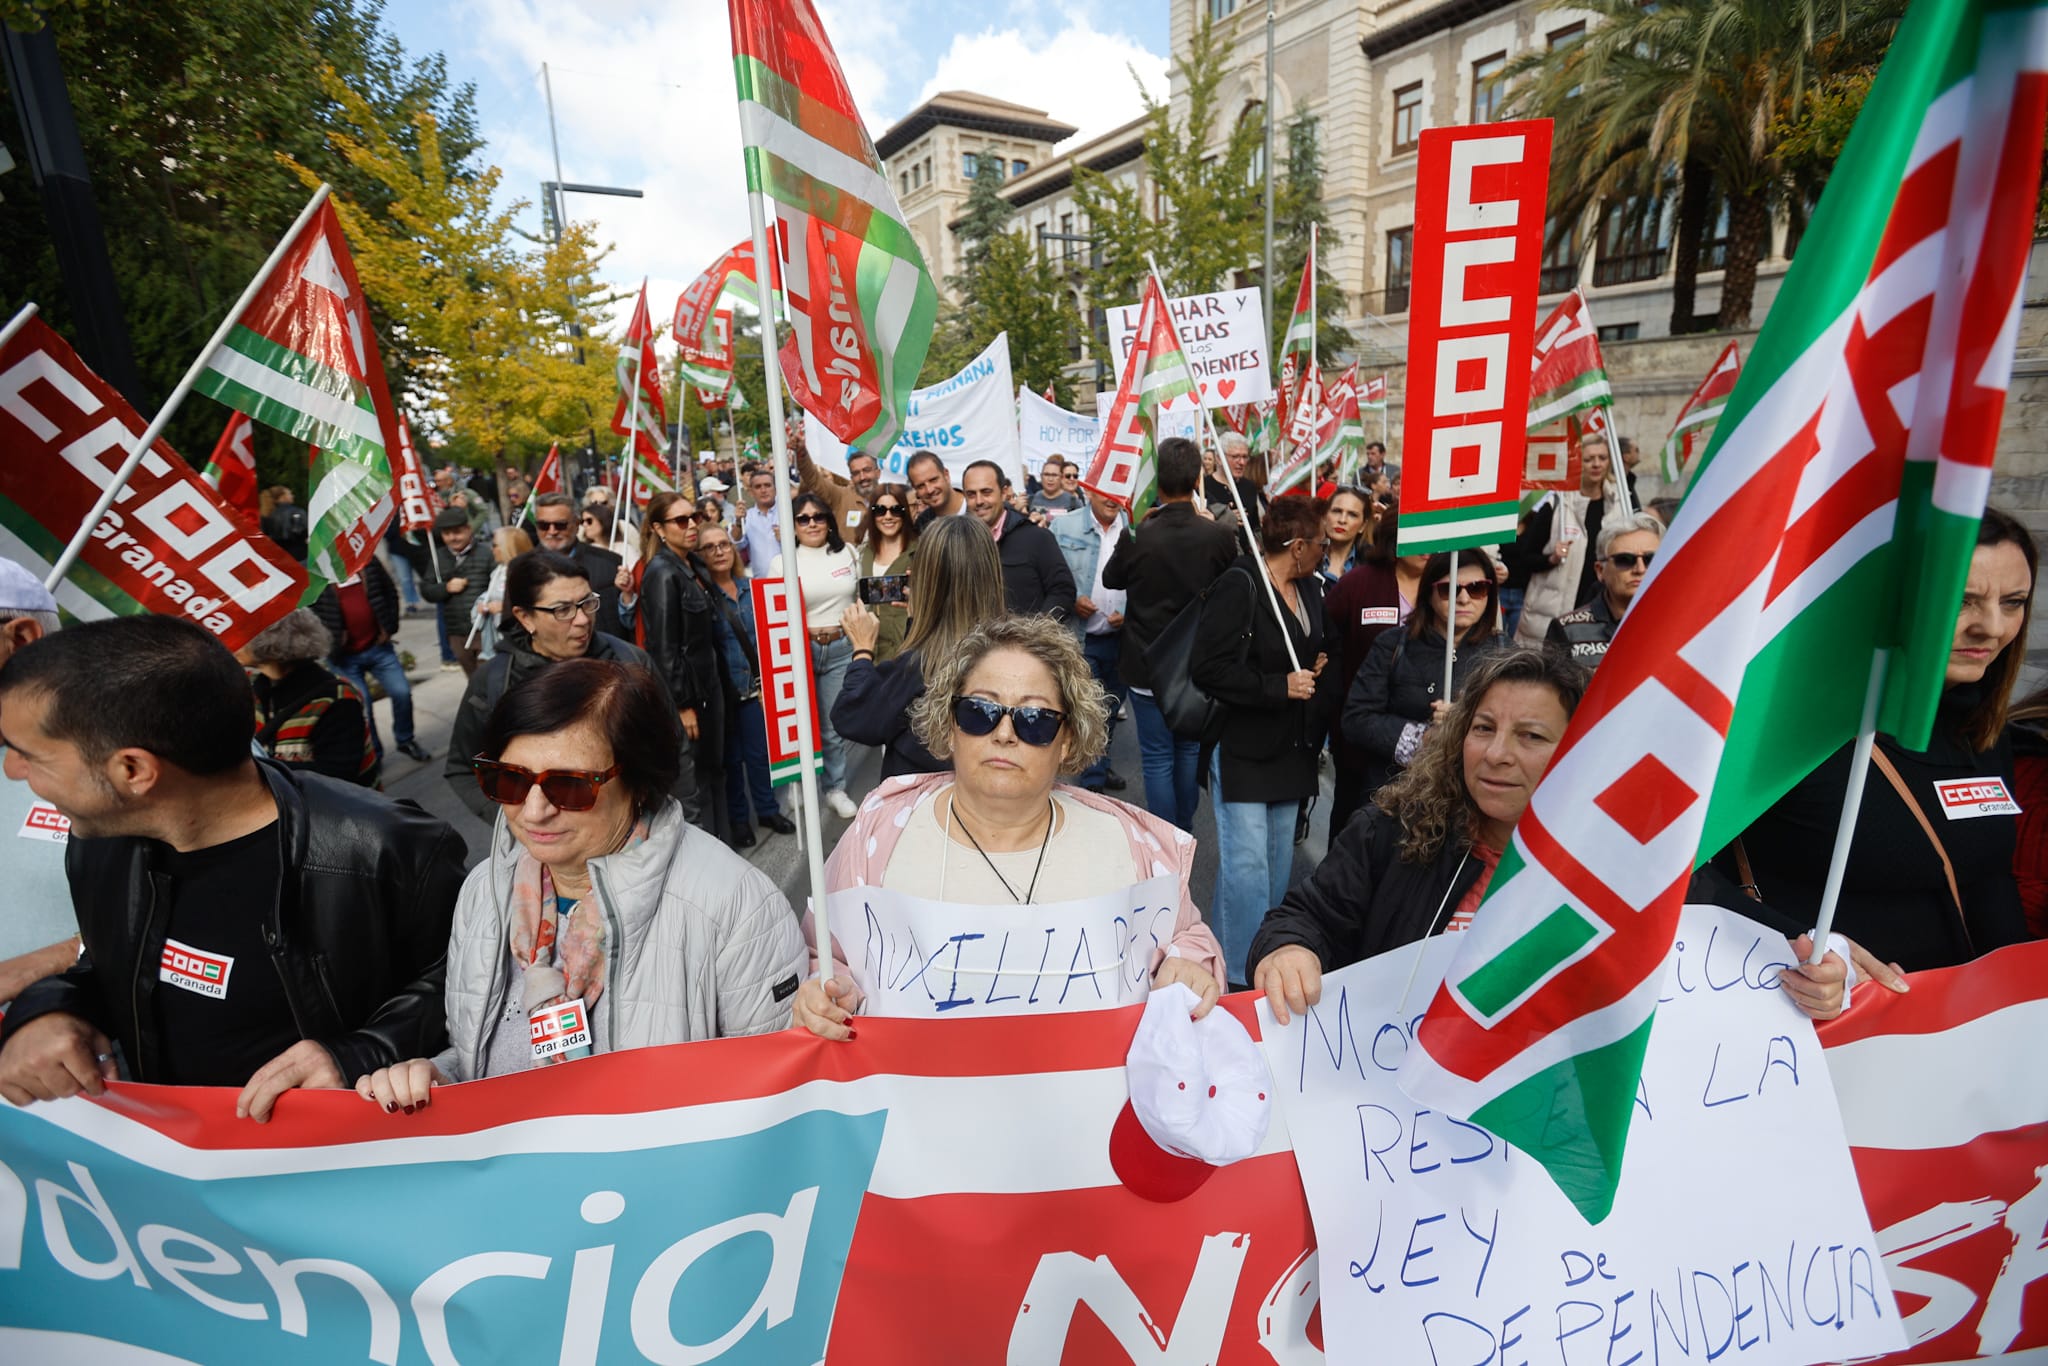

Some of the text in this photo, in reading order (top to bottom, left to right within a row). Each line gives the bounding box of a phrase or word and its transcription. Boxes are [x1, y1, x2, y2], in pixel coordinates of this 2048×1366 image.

[1123, 297, 1225, 331] LHAR
[1428, 135, 1525, 500] CCOO
[1040, 425, 1094, 443] HOY POR
[0, 349, 296, 614] CCOO
[82, 507, 234, 635] Granada
[32, 811, 71, 828] CCO
[1944, 786, 1995, 802] CCOO
[1979, 802, 2015, 812] Granada
[170, 973, 222, 995] Granada
[534, 1033, 586, 1055] Granada
[1703, 1036, 1799, 1106] LA
[0, 1160, 820, 1366] dencia
[1349, 1200, 1499, 1299] LEY
[1422, 1240, 1882, 1366] DEPENDENCIA
